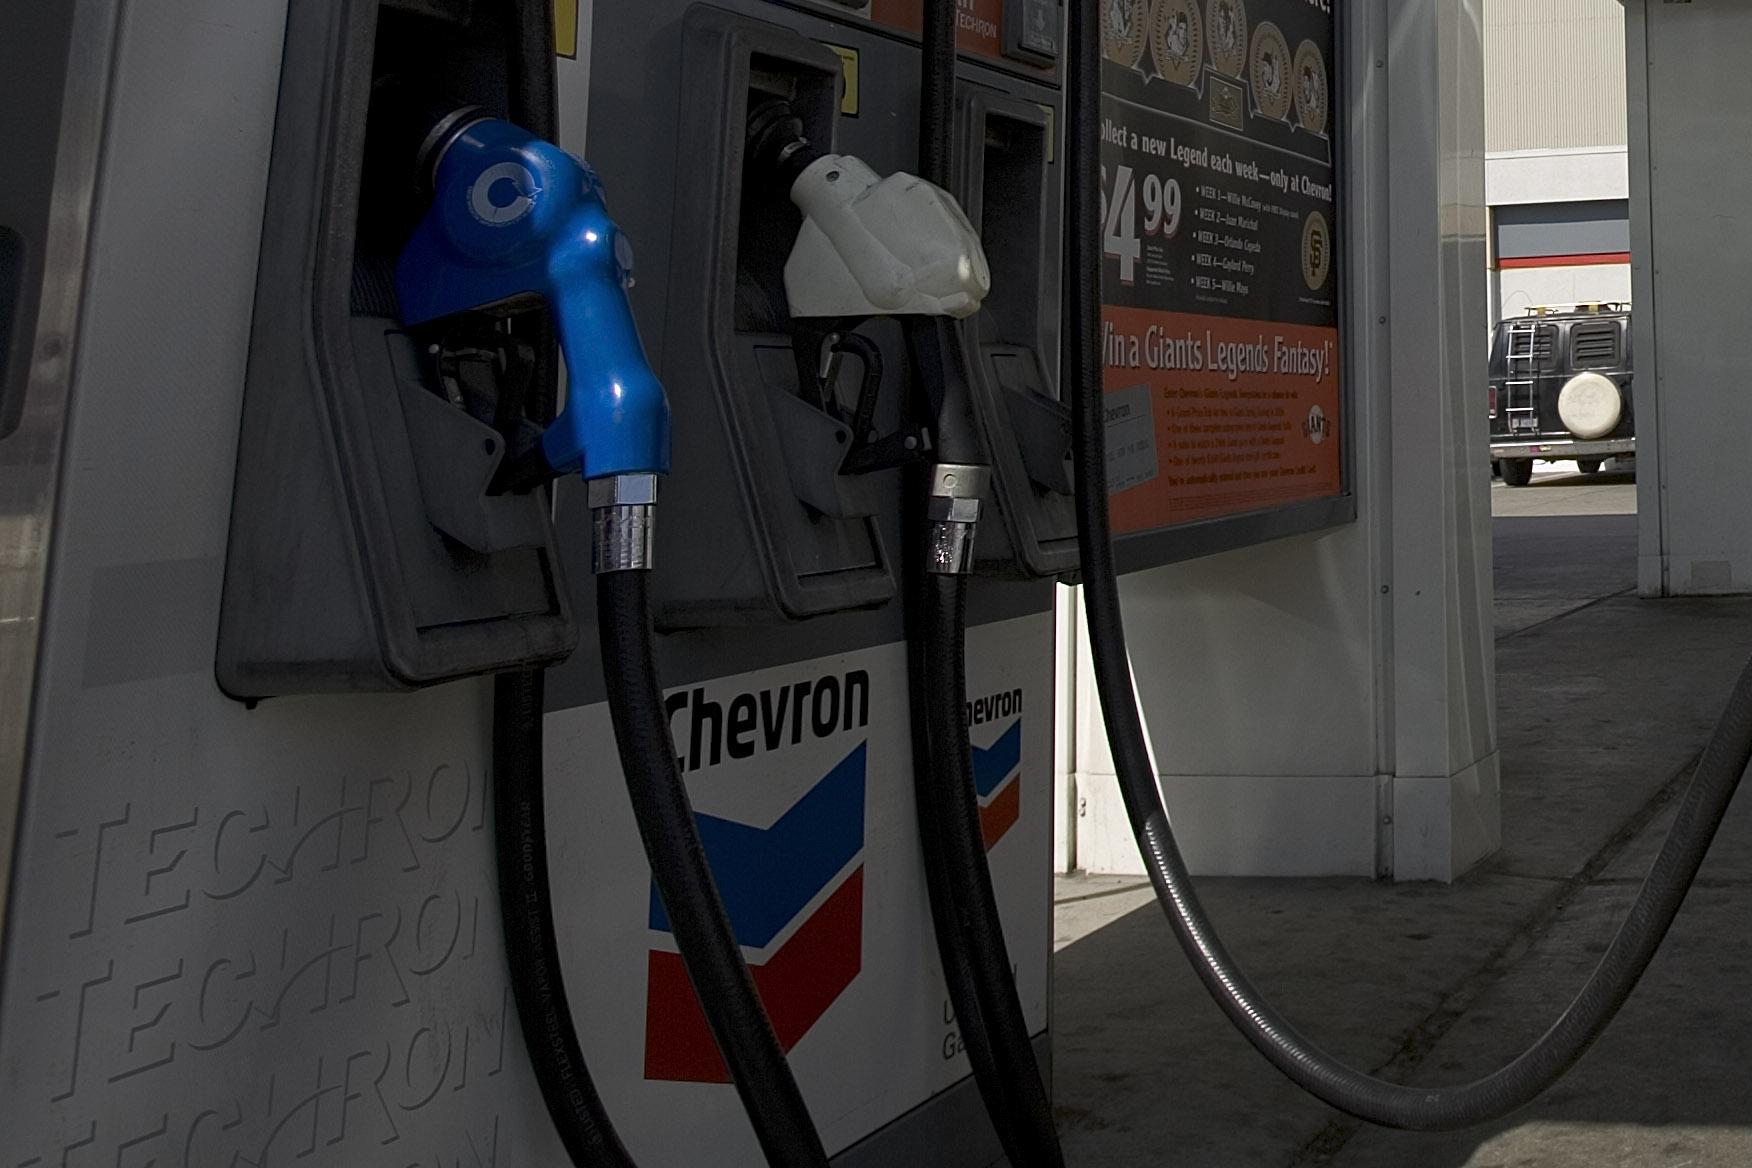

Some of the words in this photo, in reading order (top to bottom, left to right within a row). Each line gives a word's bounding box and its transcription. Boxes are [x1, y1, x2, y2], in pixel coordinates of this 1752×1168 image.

[1100, 118, 1128, 149] ollect
[1130, 132, 1138, 151] a
[1141, 133, 1168, 157] new
[1170, 136, 1209, 169] Legend
[1209, 152, 1233, 176] each
[1290, 174, 1300, 193] at
[1301, 175, 1333, 203] Chevron!
[1130, 335, 1140, 369] a
[1146, 325, 1202, 371] Giants
[1207, 330, 1269, 382] Legends
